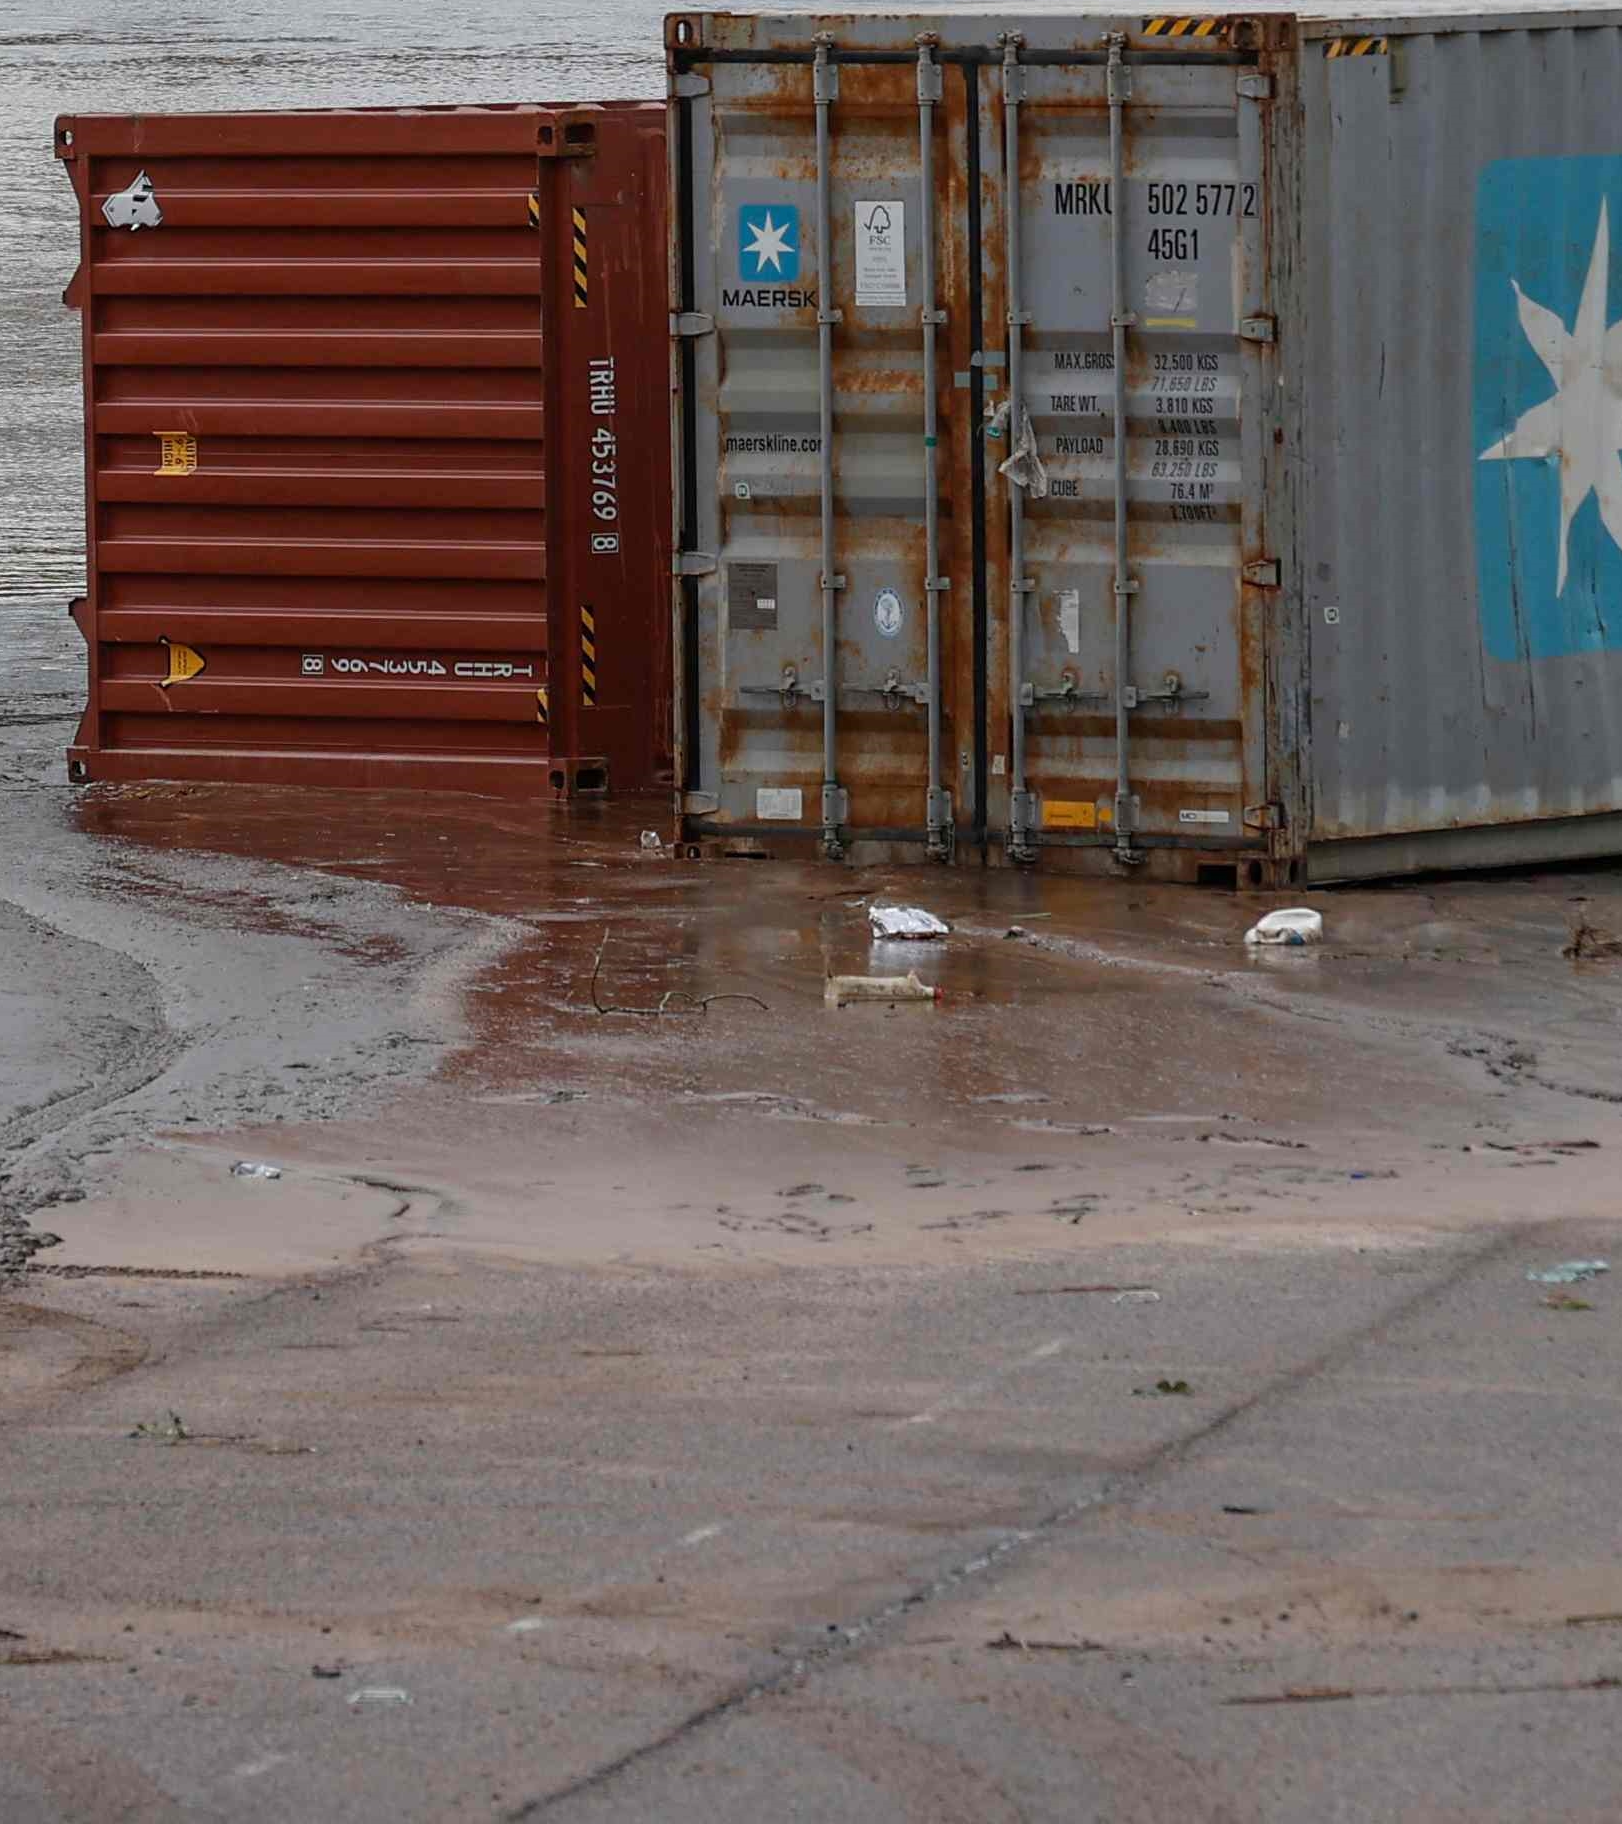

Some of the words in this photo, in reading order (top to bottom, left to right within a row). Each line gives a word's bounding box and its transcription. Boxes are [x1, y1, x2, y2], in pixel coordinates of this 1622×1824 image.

[1148, 183, 1188, 215] 502
[1196, 184, 1236, 216] 577
[1242, 183, 1257, 217] 2
[869, 236, 890, 245] FSC
[1148, 228, 1199, 260] 45G1
[722, 289, 818, 307] MAERSK
[1197, 353, 1219, 371] KGS
[588, 356, 616, 417] TRHU
[1194, 377, 1218, 393] LBS
[1051, 395, 1076, 412] TARE
[1078, 396, 1100, 413] WT.
[1192, 397, 1214, 415] KGS
[1195, 419, 1219, 436] LBS
[1056, 437, 1103, 454] PAYLOAD
[1197, 439, 1219, 457] KGS
[590, 426, 618, 521] 453769
[1194, 461, 1219, 478] LBS
[1051, 479, 1078, 496] CUBE
[1170, 482, 1195, 500] 76.4
[592, 533, 617, 552] 8
[330, 656, 447, 679] 453769
[454, 660, 533, 679] TRHU
